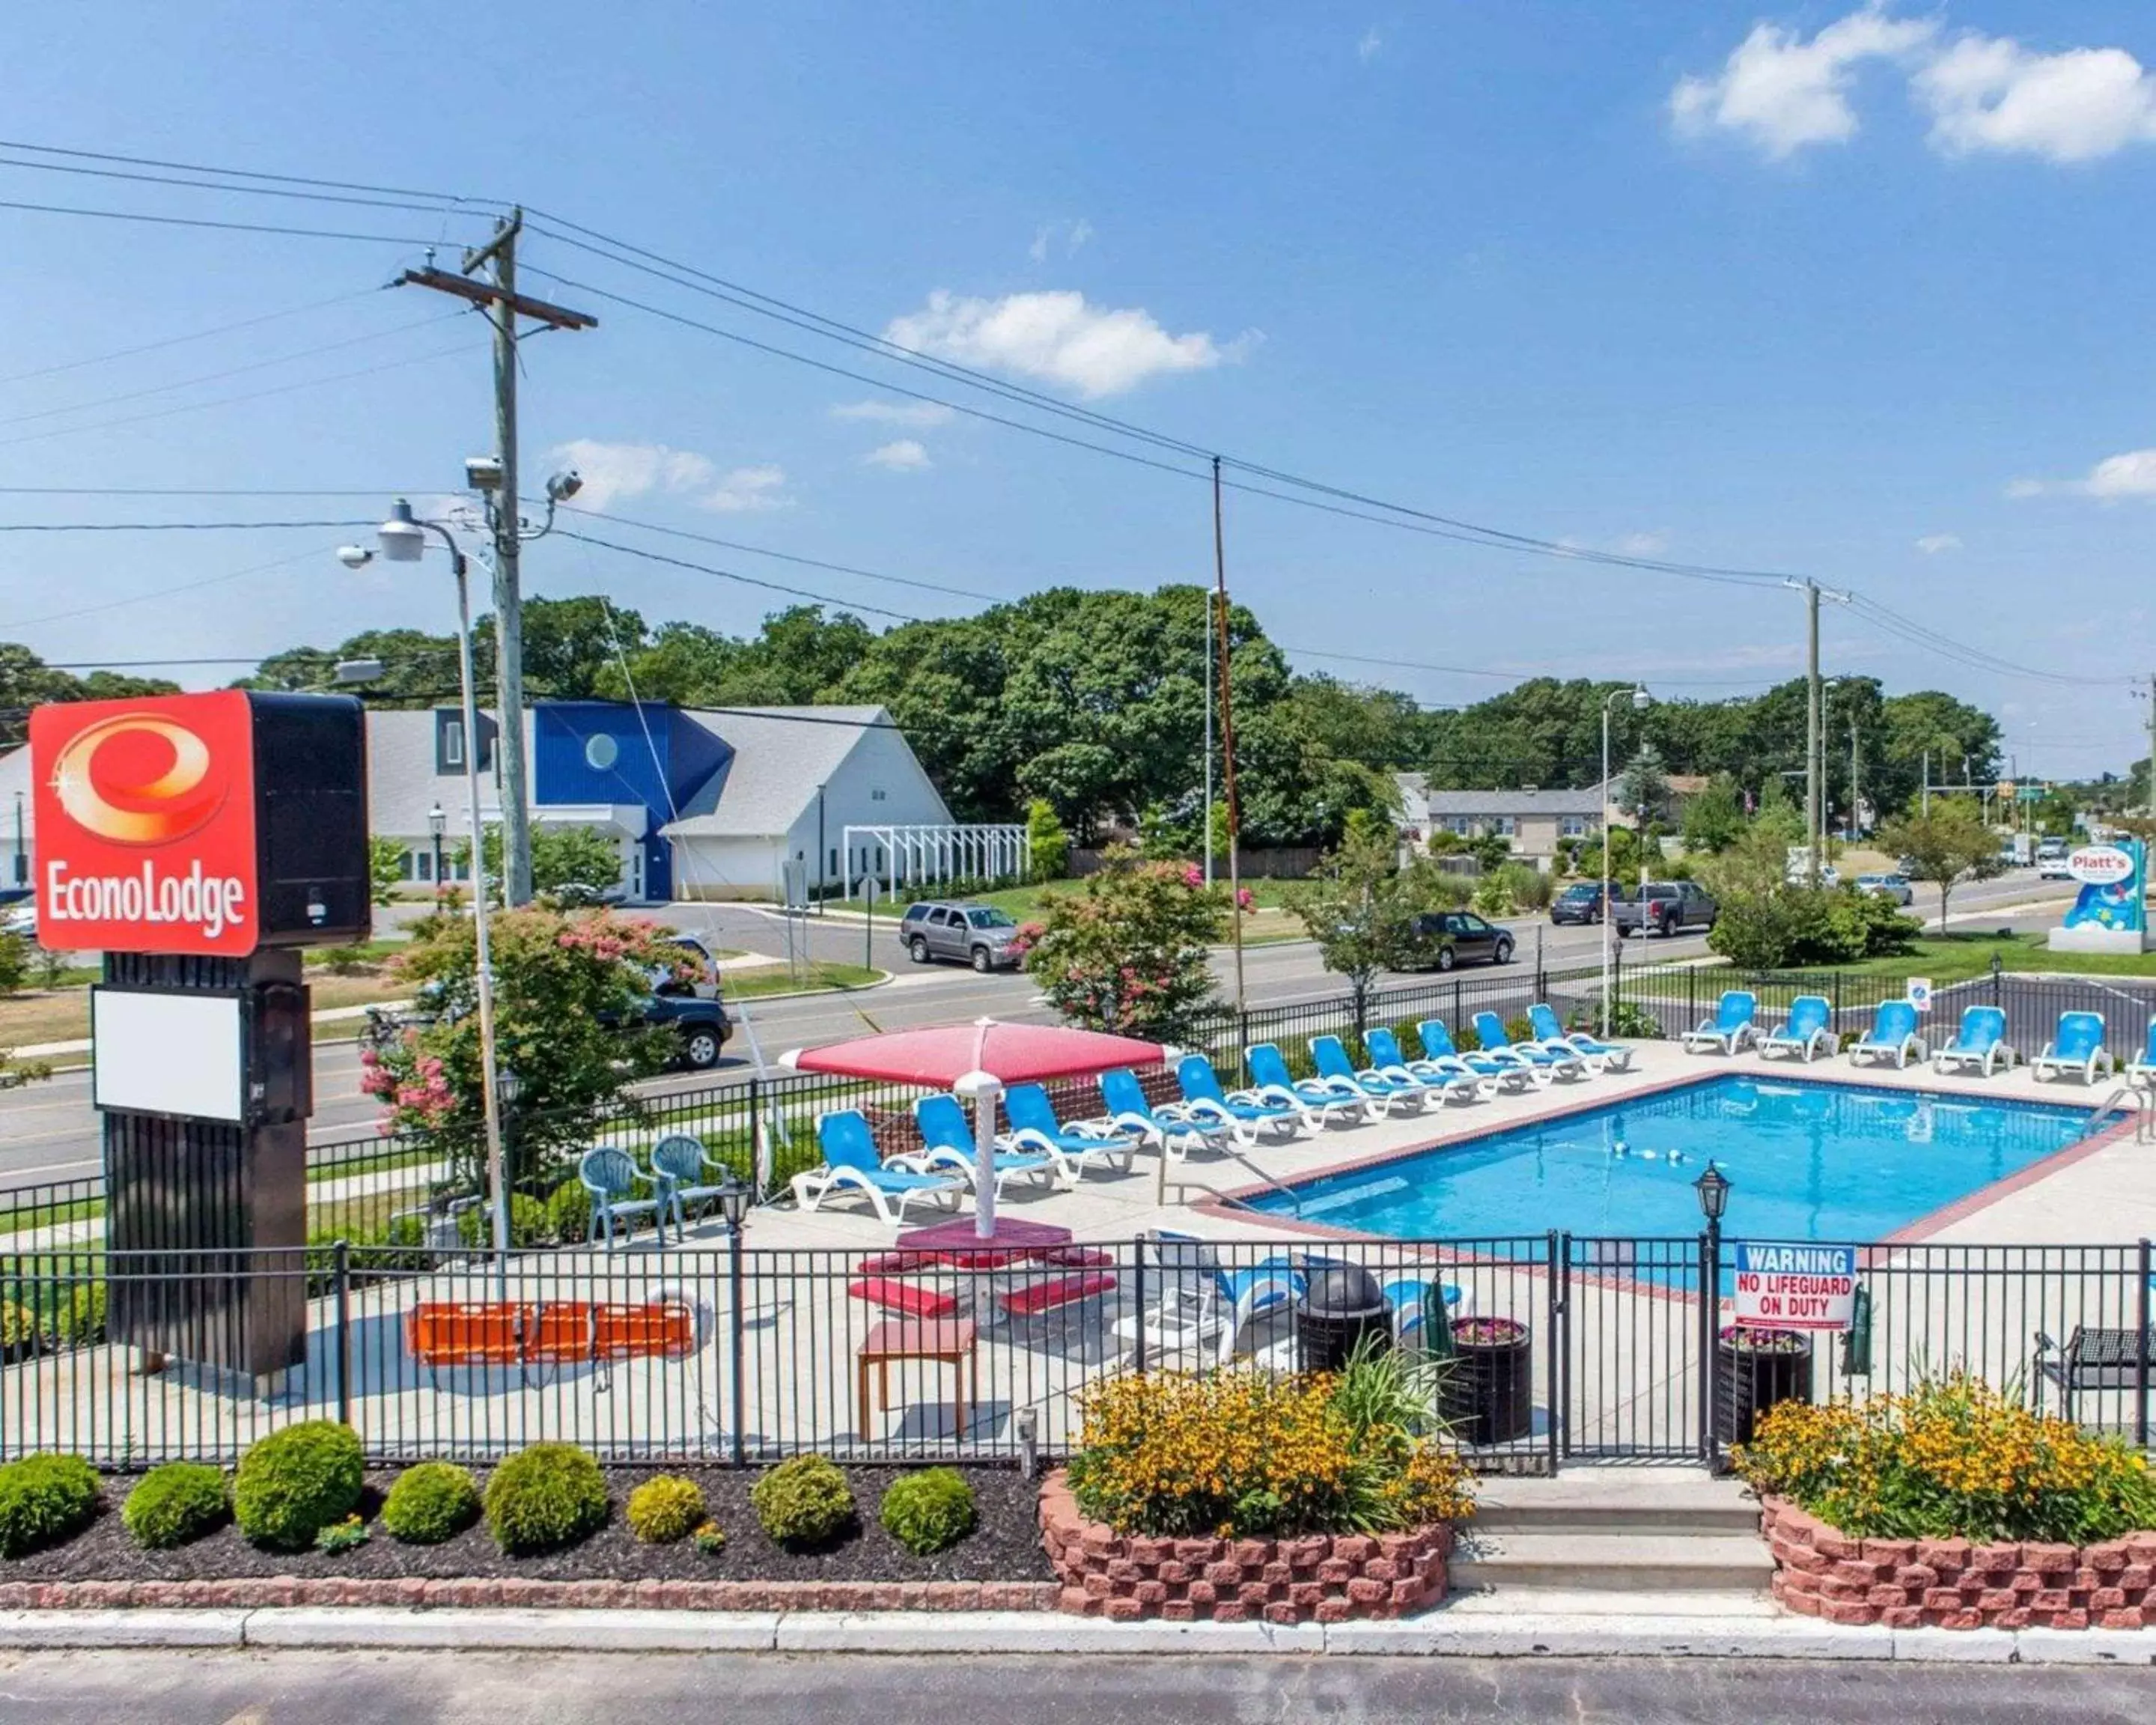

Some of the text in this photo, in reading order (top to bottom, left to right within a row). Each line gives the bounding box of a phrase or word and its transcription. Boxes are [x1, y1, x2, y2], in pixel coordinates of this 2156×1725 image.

[2072, 856, 2127, 868] Platt's
[47, 860, 245, 938] EconoLodge
[1747, 1247, 1847, 1273] WARNING
[1738, 1274, 1851, 1295] NO LIFEGUARD
[1760, 1297, 1829, 1316] ON DUTY
